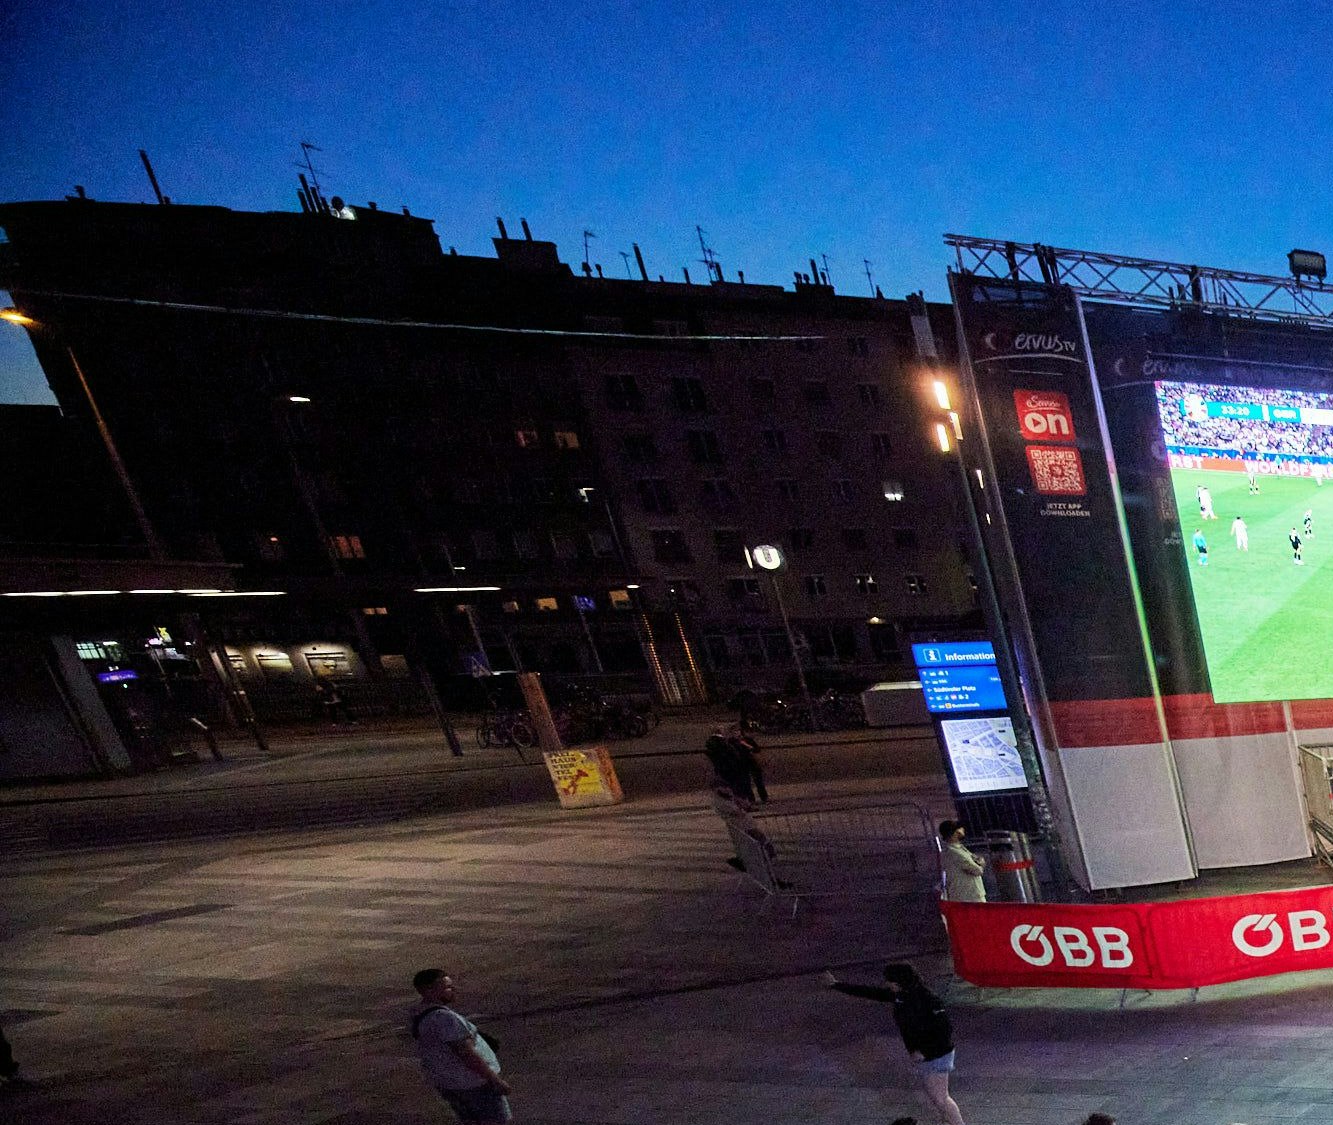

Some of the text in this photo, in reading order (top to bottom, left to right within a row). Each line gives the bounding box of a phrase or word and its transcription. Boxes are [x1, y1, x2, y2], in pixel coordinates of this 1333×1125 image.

[1025, 412, 1069, 435] on
[945, 652, 996, 661] Information
[1010, 923, 1134, 969] ÖBB
